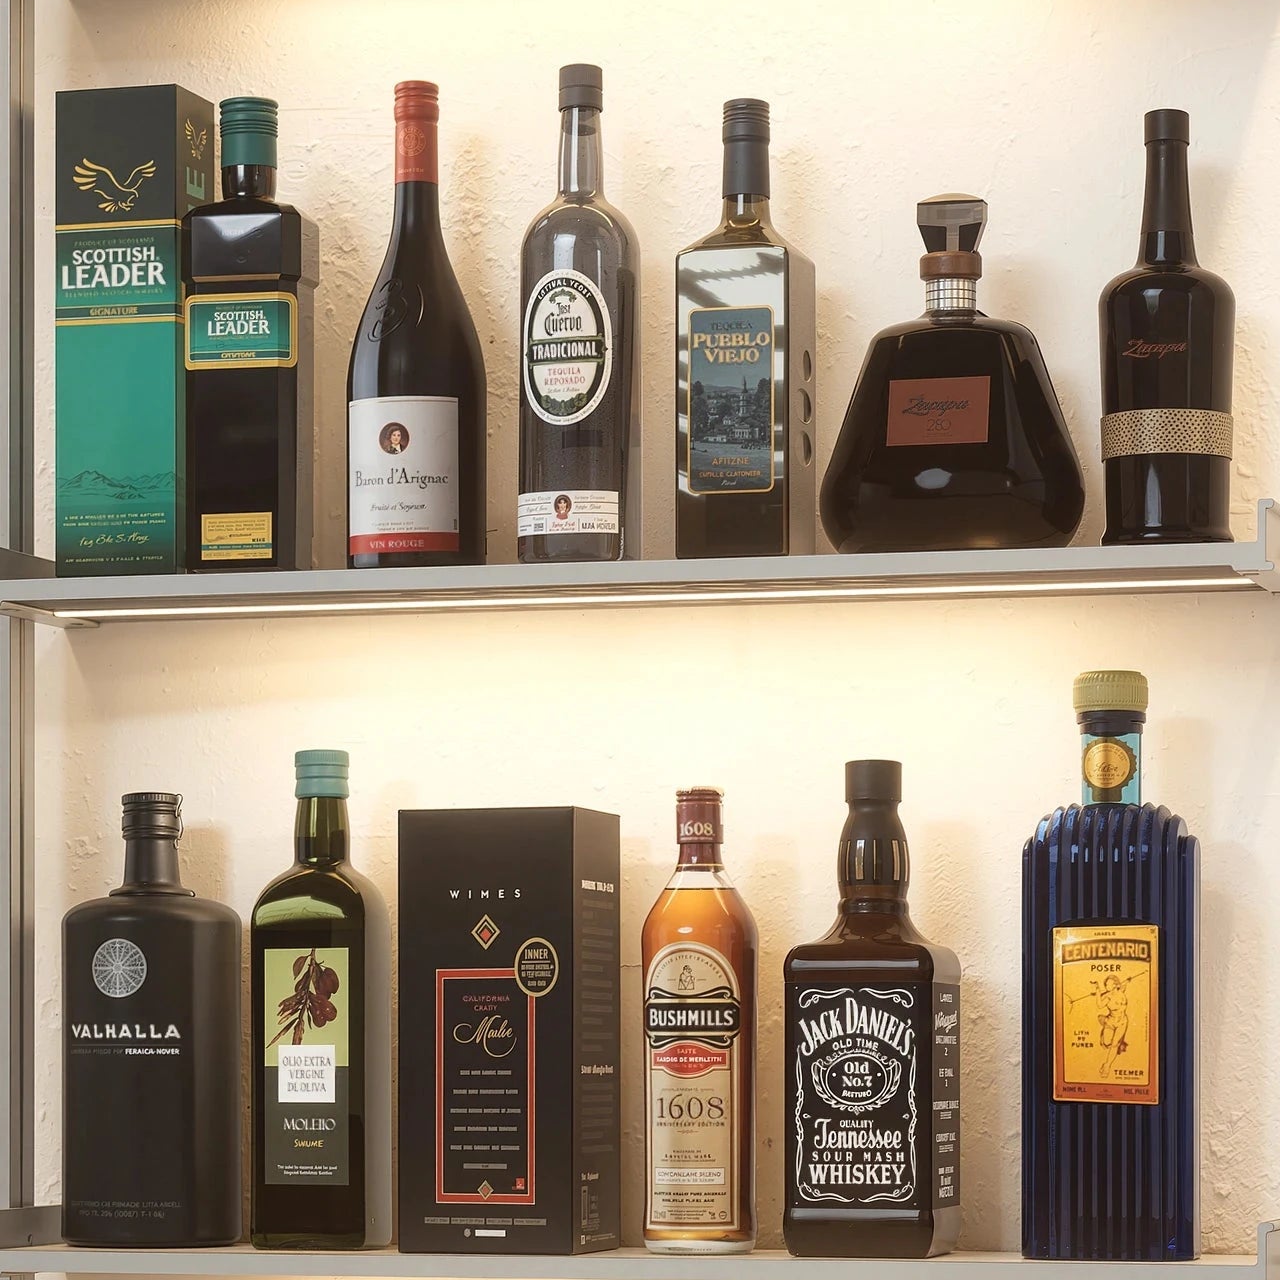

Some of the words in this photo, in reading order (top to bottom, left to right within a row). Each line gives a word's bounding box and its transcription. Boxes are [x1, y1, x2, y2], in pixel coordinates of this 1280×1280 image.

[72, 246, 155, 265] SCOTTISH
[62, 262, 166, 290] LEADER
[214, 310, 264, 321] SCOTTISH
[207, 320, 270, 336] LEADER
[693, 332, 770, 349] PUEBLO
[532, 341, 598, 361] TRADICIONAL
[704, 348, 760, 363] VIEJO
[544, 376, 586, 386] REPOSADO
[387, 467, 449, 489] d'Arignac
[369, 541, 385, 549] VIN
[388, 540, 424, 549] ROUGE
[680, 820, 714, 836] 1608
[449, 888, 521, 900] WIMES
[524, 948, 549, 960] INNER
[1064, 942, 1149, 962] CENTENARIO
[1090, 964, 1121, 972] POSER
[649, 1008, 734, 1026] BUSHMILLS
[72, 1023, 181, 1039] VALHALLA
[799, 1007, 844, 1056] JACK
[832, 1038, 853, 1051] OLD
[856, 1038, 879, 1051] TIME
[304, 1056, 331, 1067] EXTRA
[844, 1061, 870, 1074] Old
[288, 1069, 325, 1080] VERGINE
[301, 1082, 327, 1092] OLIVA
[656, 1093, 725, 1120] 1608
[814, 1118, 902, 1149] Tennessee
[812, 1151, 853, 1161] SOUR
[863, 1151, 905, 1161] MASH
[808, 1164, 906, 1185] WHISKEY
